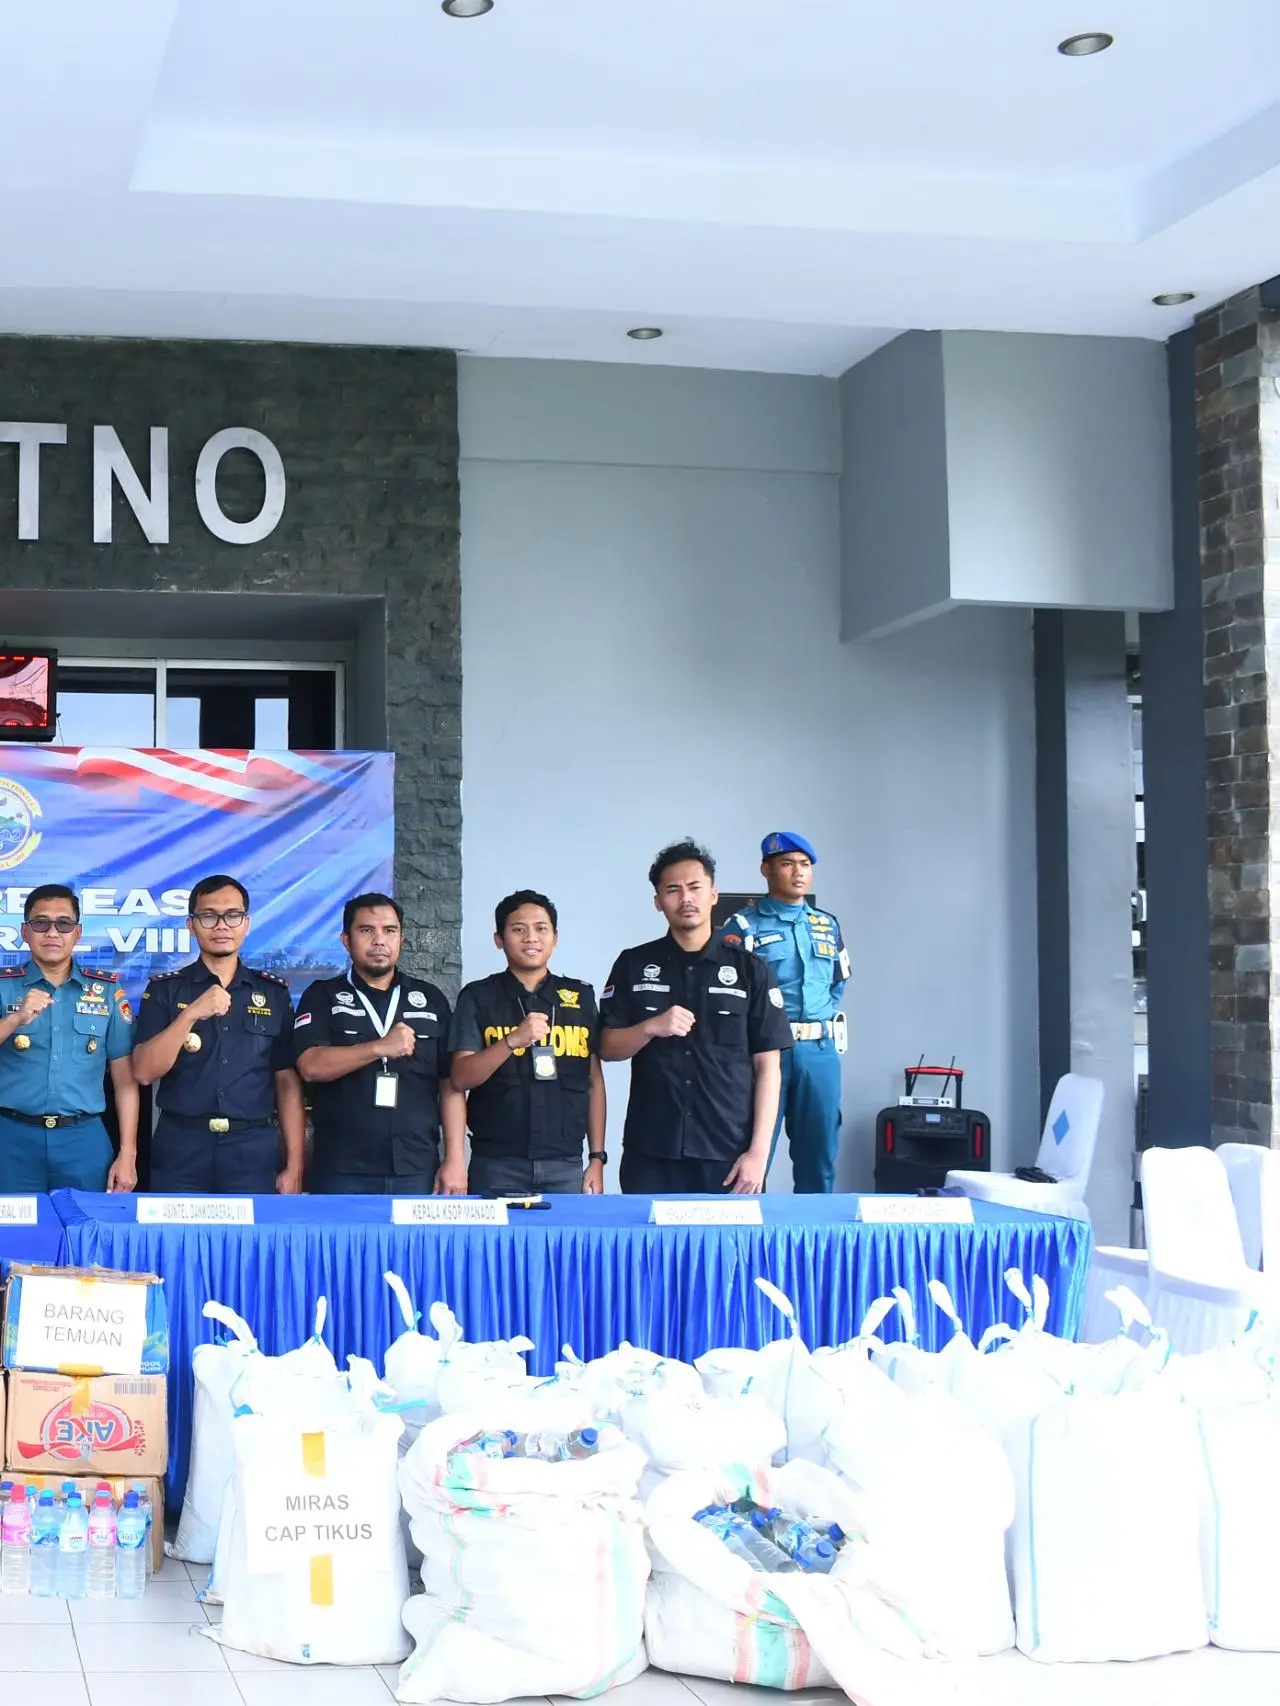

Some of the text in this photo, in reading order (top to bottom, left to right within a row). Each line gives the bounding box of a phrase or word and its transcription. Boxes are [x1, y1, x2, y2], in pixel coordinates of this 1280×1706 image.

[106, 927, 191, 953] VIII
[412, 1204, 441, 1220] KEPALA
[44, 1303, 124, 1324] BARANG
[43, 1325, 122, 1347] TEMUAN
[285, 1494, 350, 1511] MIRAS
[265, 1523, 373, 1542] CAP TIKUS
